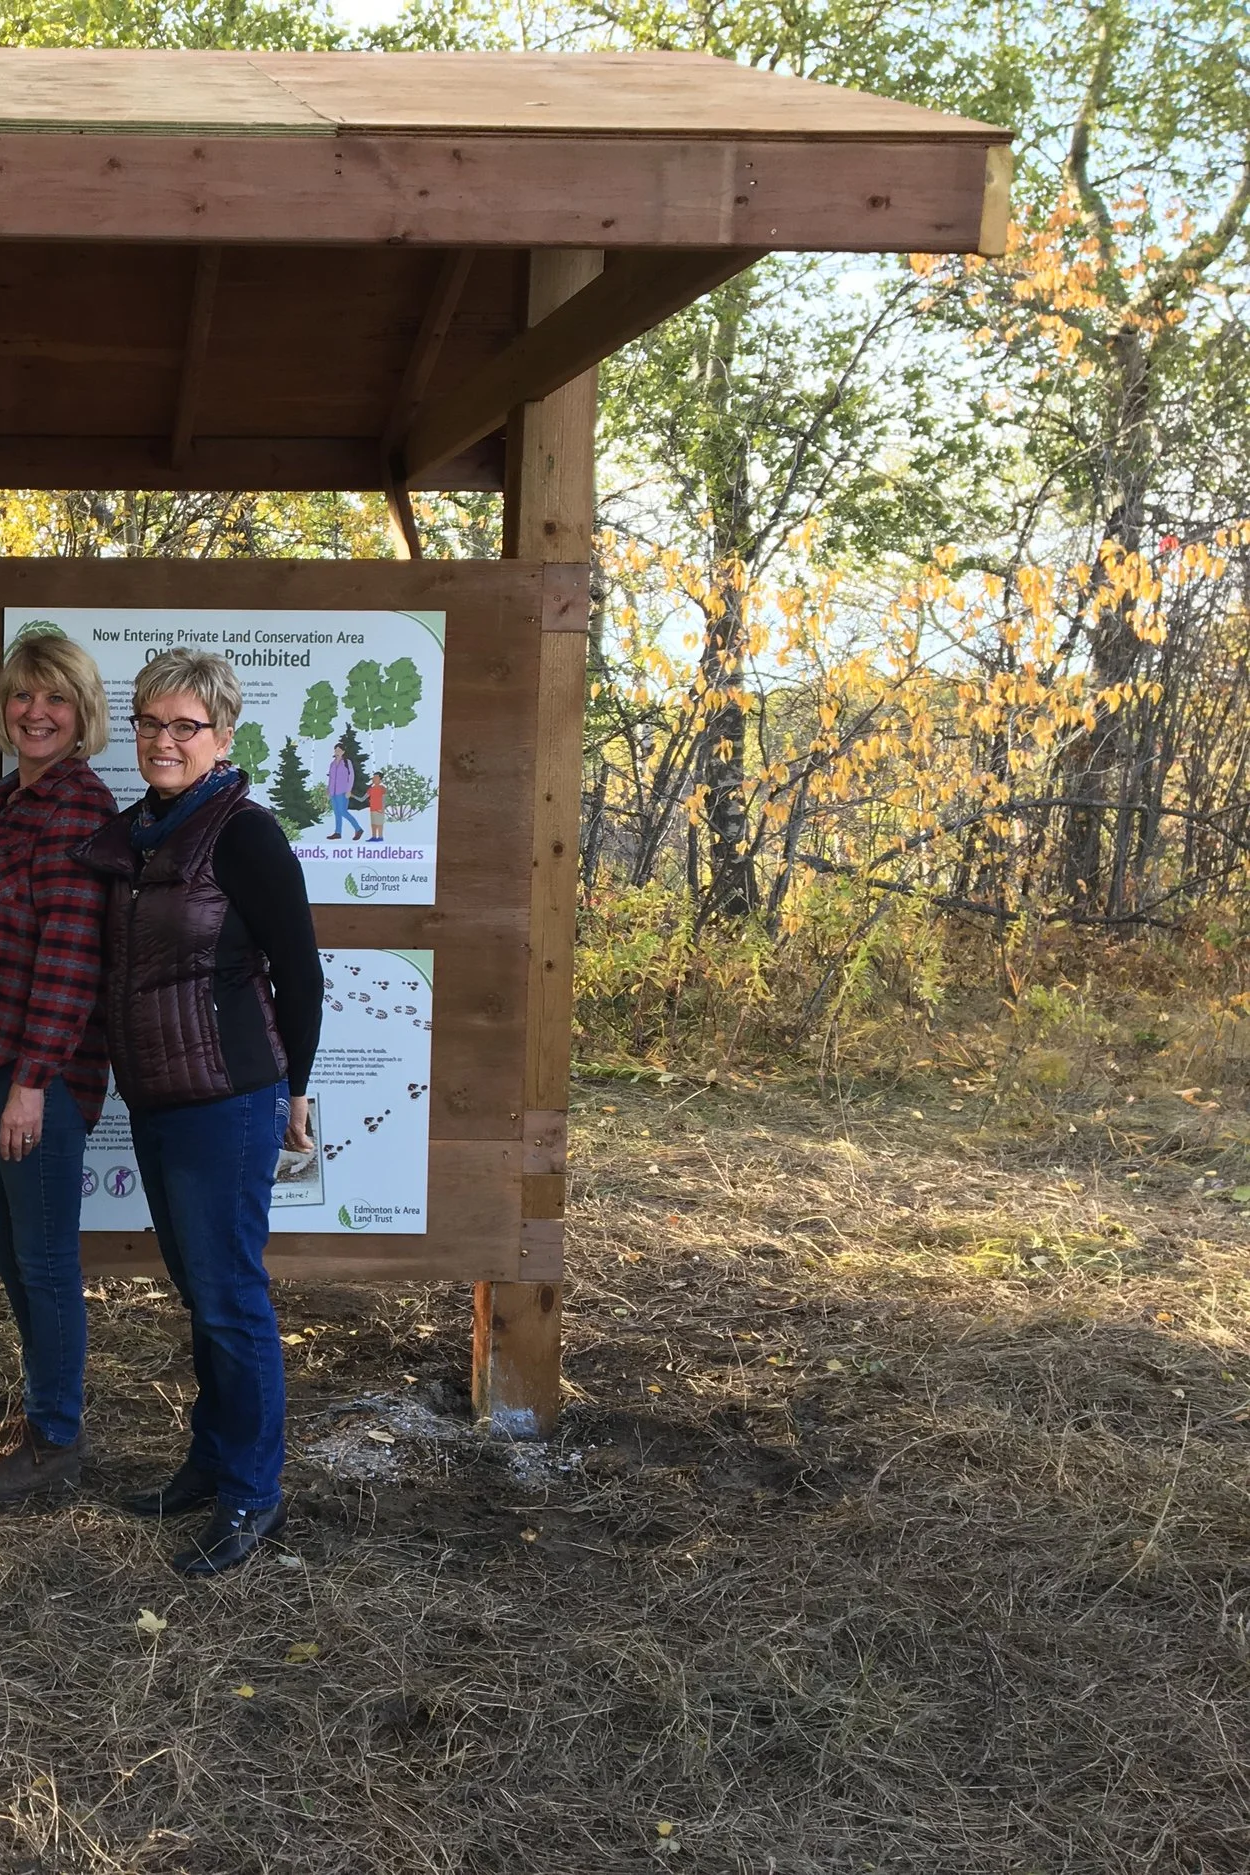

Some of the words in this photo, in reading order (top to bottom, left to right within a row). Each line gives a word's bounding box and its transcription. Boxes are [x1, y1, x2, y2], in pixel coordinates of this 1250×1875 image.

[92, 629, 119, 642] Now
[124, 630, 173, 646] Entering
[177, 630, 218, 642] Private
[223, 630, 250, 643] Land
[255, 631, 332, 644] Conservation
[337, 632, 364, 644] Area
[225, 649, 310, 667] Prohibited
[291, 846, 328, 860] Hands,
[333, 848, 352, 858] not
[357, 846, 423, 859] Handlebars
[361, 874, 399, 882] Edmonton
[402, 874, 408, 882] &
